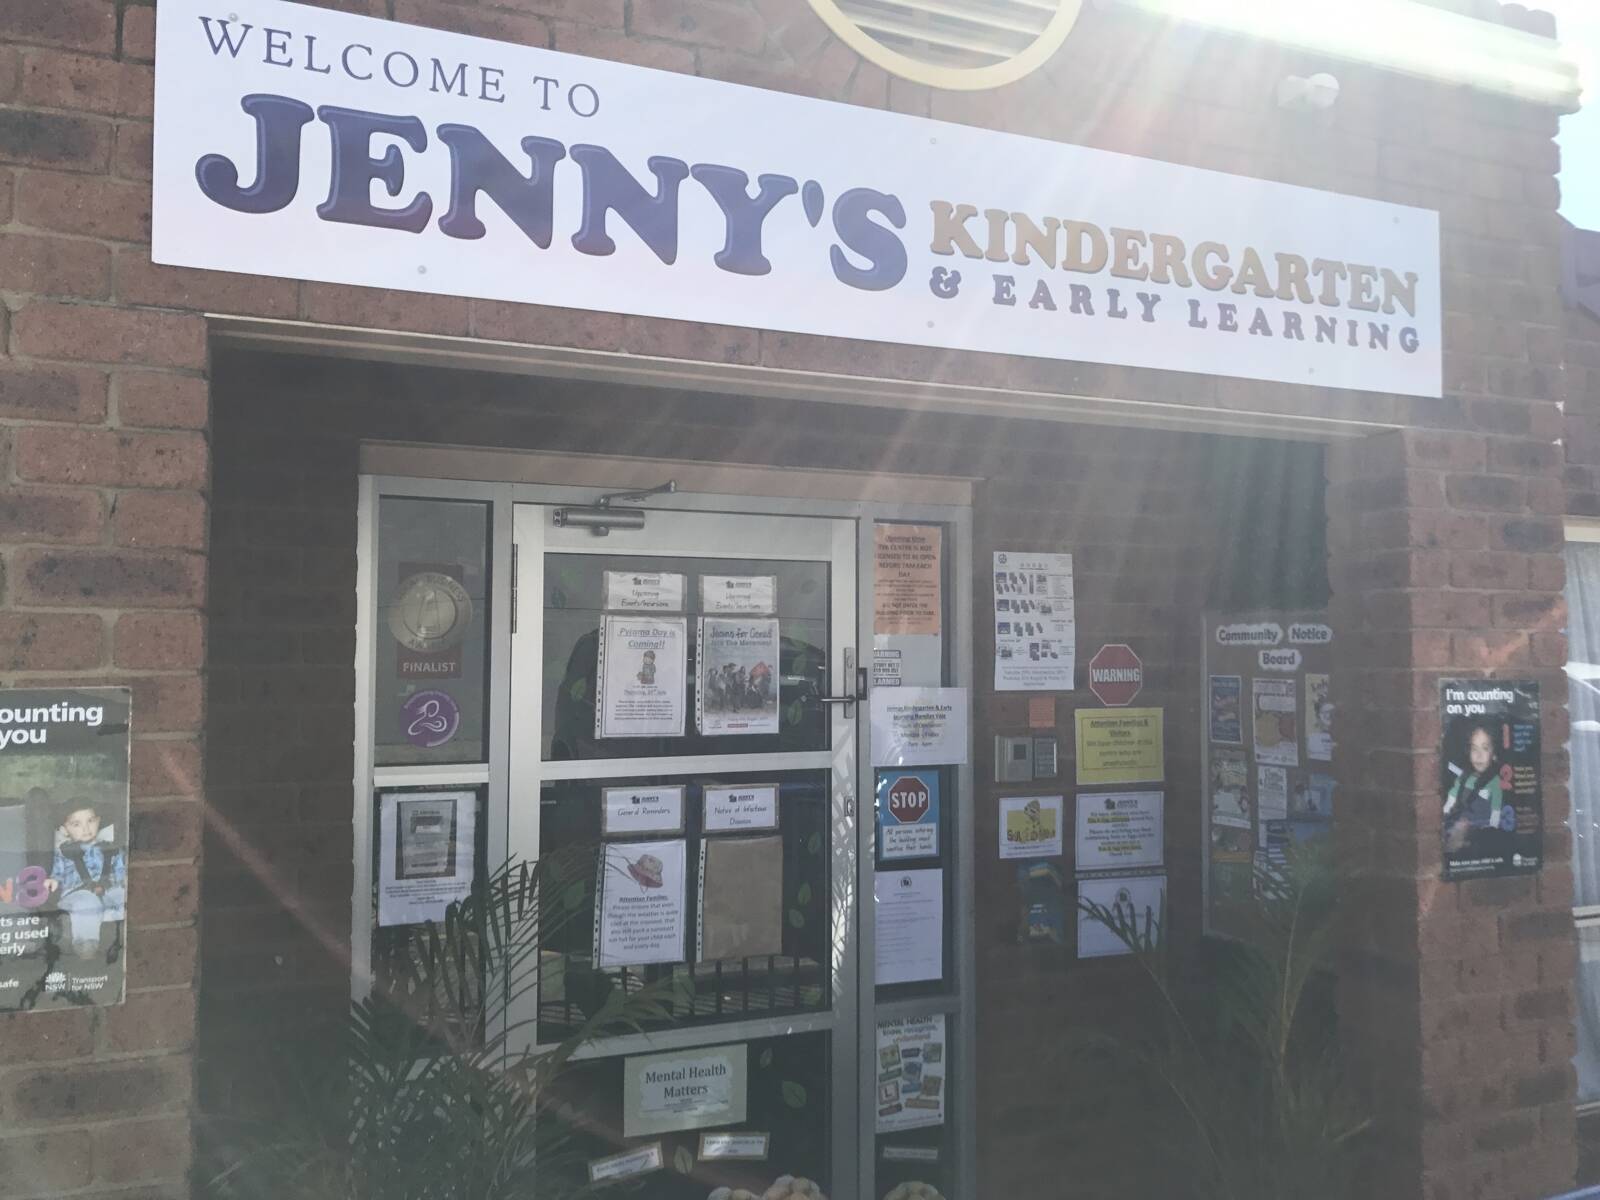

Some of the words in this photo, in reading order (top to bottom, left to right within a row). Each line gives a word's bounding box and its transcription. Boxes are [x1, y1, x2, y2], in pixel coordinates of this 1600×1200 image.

[198, 16, 506, 104] WELCOME
[532, 75, 601, 118] TO
[194, 92, 908, 291] JENNY'S
[929, 199, 1419, 318] KINDERGARTEN
[929, 265, 961, 300] &
[992, 274, 1162, 322] EARLY
[1188, 298, 1420, 354] LEARNING
[1218, 628, 1278, 642] Community
[1292, 628, 1327, 640] Notice
[1262, 652, 1296, 665] Board
[403, 662, 456, 672] FINALIST
[1092, 668, 1140, 683] WARNING
[1446, 688, 1465, 701] I'm
[1467, 688, 1514, 703] counting
[1446, 703, 1463, 714] on
[1464, 703, 1486, 717] you
[891, 791, 927, 809] STOP
[16, 916, 40, 926] are
[15, 926, 49, 940] used
[645, 1067, 686, 1085] Mental
[689, 1063, 727, 1080] Health
[663, 1085, 709, 1100] Matters
